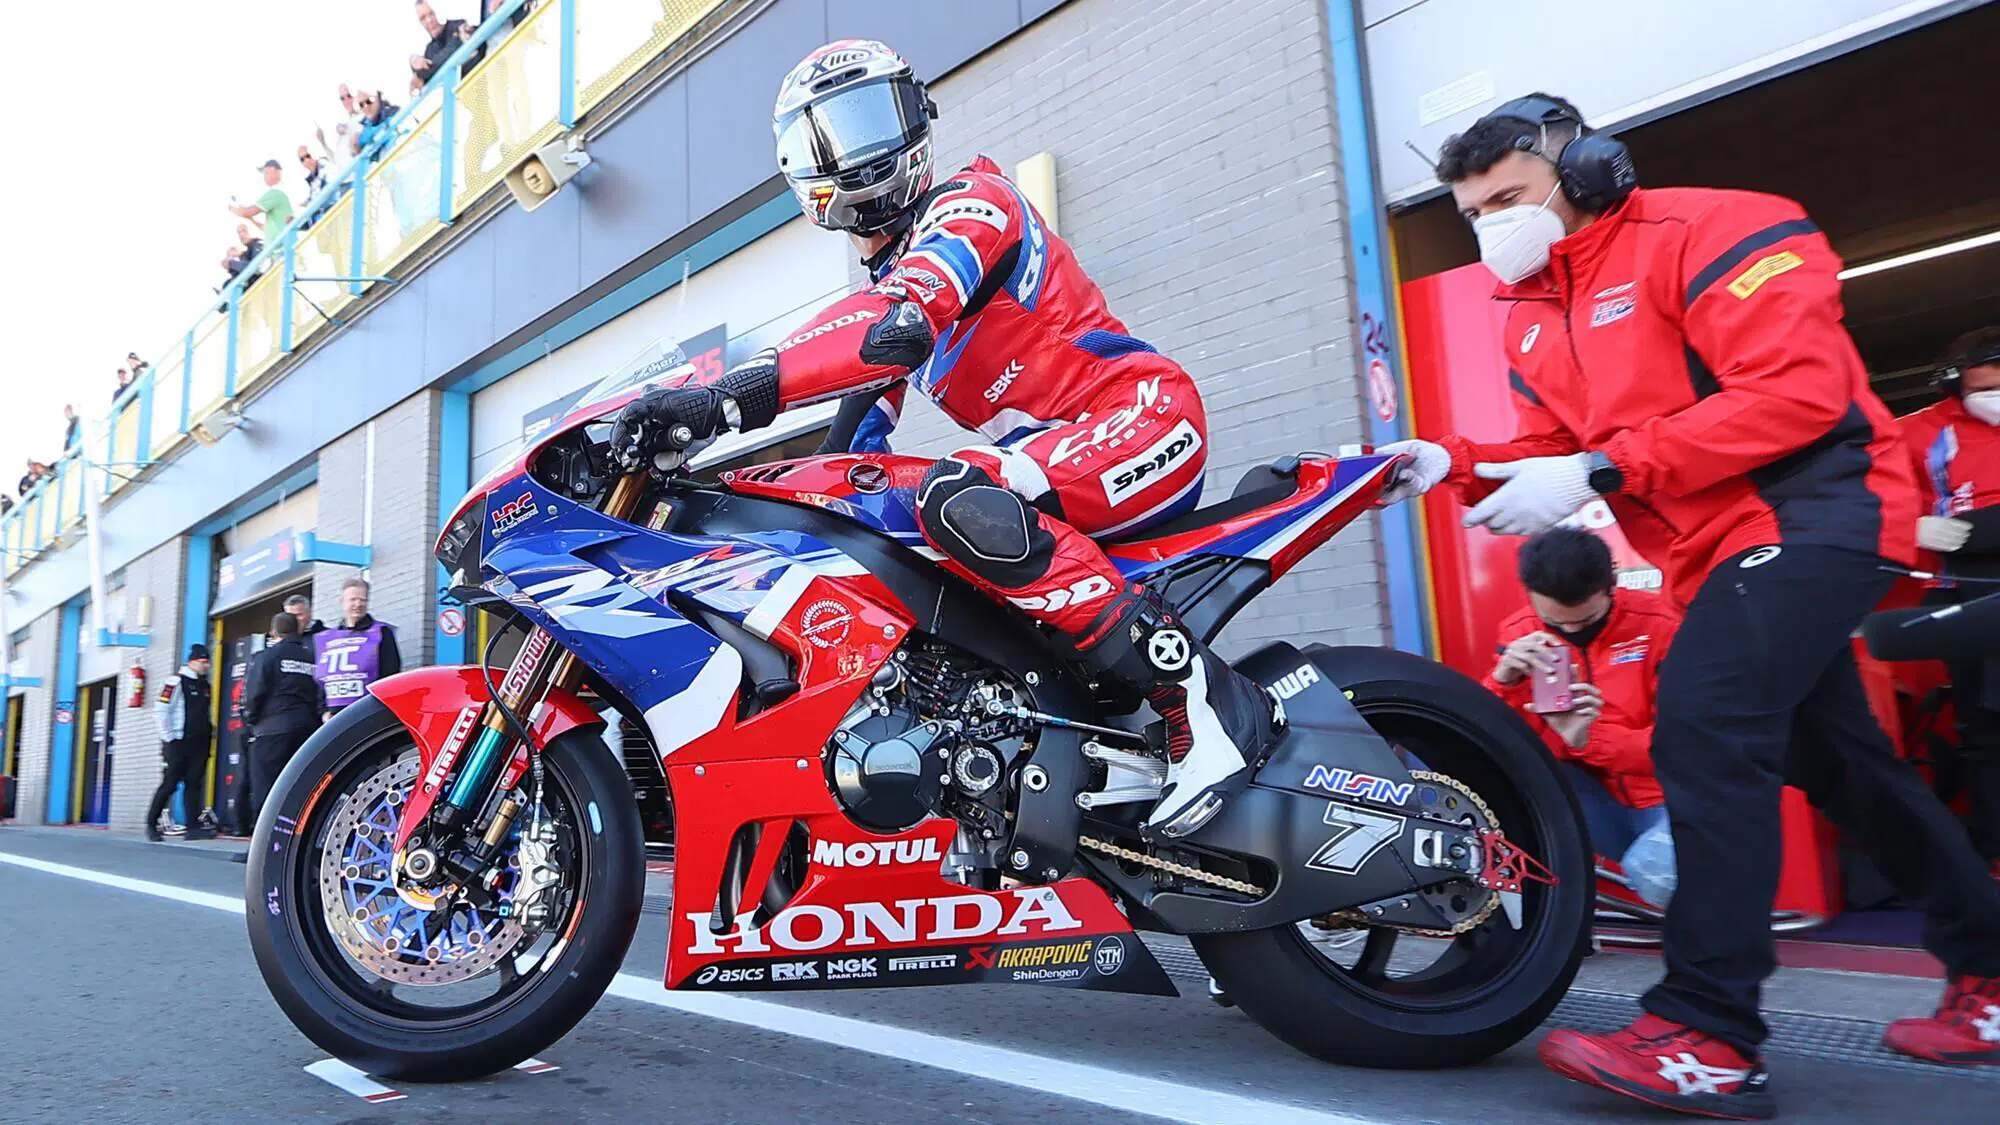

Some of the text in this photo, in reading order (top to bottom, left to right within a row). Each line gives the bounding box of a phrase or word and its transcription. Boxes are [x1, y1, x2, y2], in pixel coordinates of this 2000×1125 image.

[777, 309, 878, 352] HONDA
[983, 358, 1025, 403] SBK
[1112, 432, 1193, 495] SPIDI
[491, 491, 534, 529] HRC
[511, 626, 553, 696] SHOWA
[425, 707, 477, 788] PIRELLI
[813, 837, 942, 867] MOTUL
[1305, 800, 1407, 876] 7
[686, 886, 1083, 955] HONDA
[718, 966, 765, 982] asics
[771, 961, 819, 979] RK
[826, 957, 877, 974] NGK
[889, 955, 957, 972] PIRELLI
[1012, 968, 1079, 981] ShinDengen
[1097, 948, 1122, 965] STM
